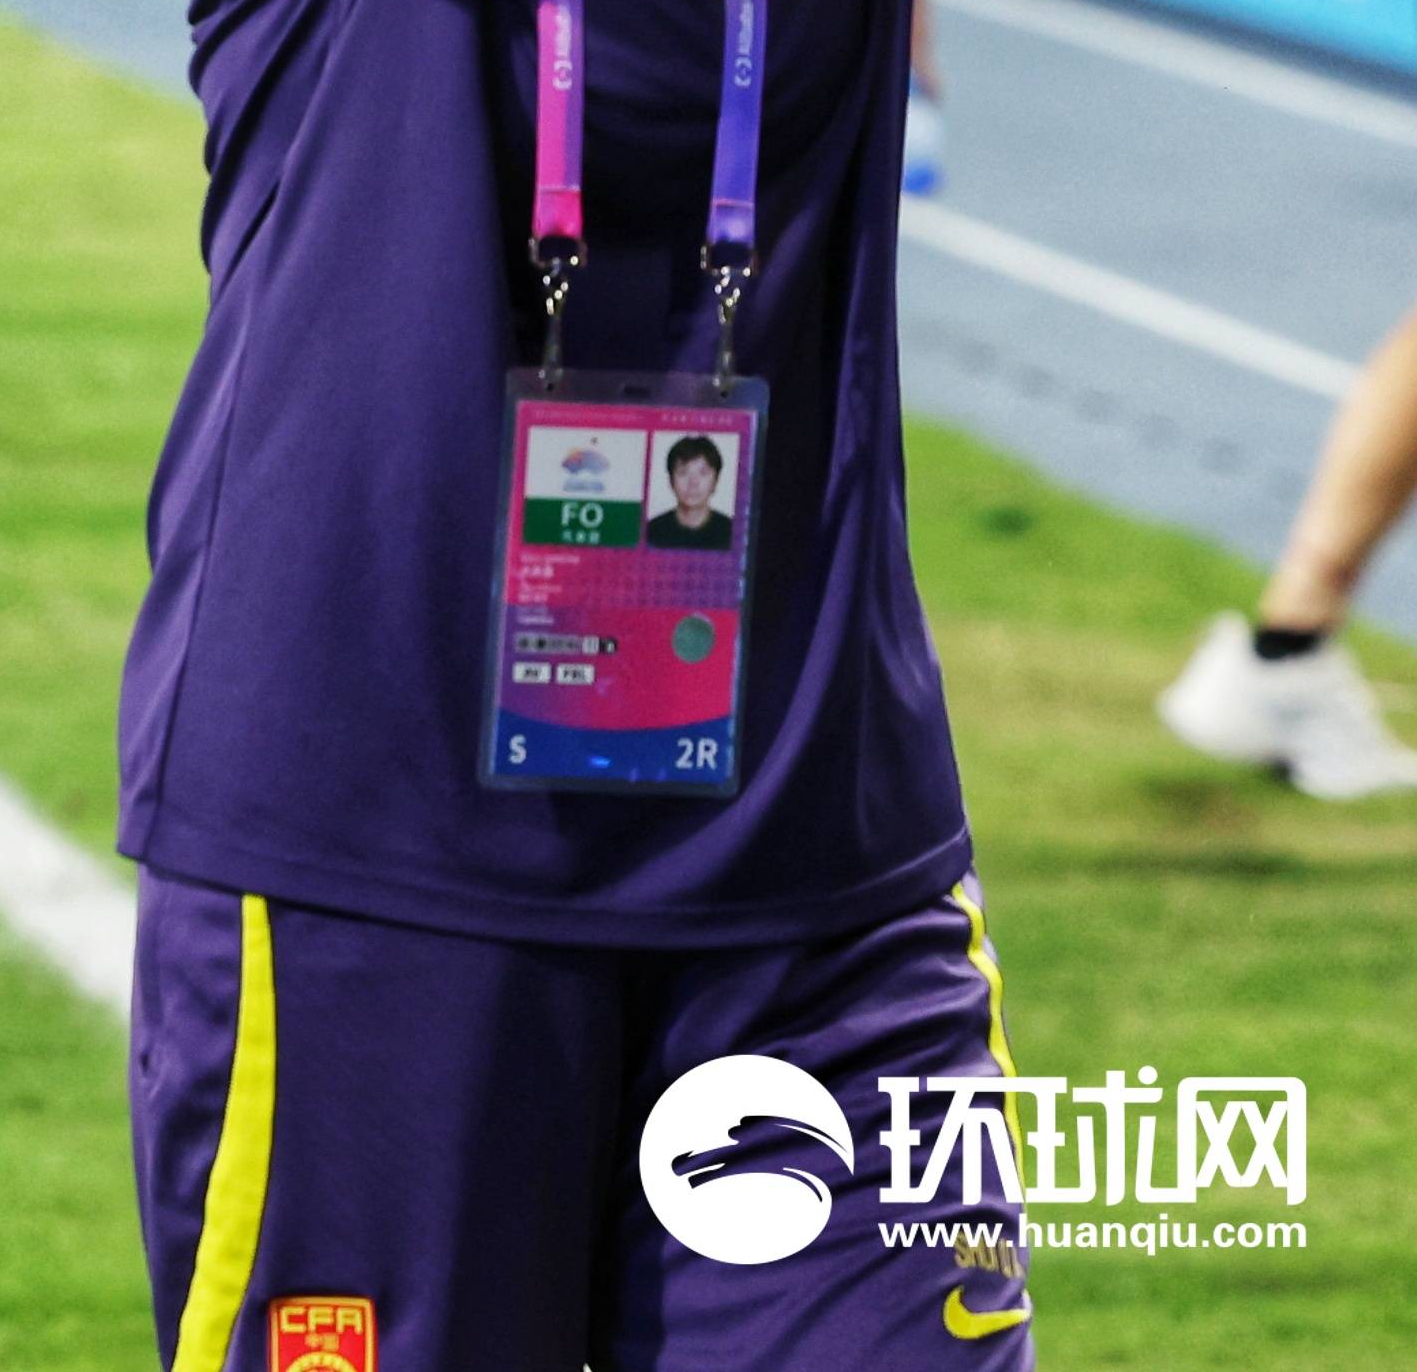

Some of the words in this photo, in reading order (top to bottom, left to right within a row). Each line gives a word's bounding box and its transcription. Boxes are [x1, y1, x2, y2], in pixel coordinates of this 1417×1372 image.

[560, 501, 604, 529] FO
[508, 734, 528, 765] S
[675, 738, 718, 770] 2R
[280, 1305, 364, 1335] CFA
